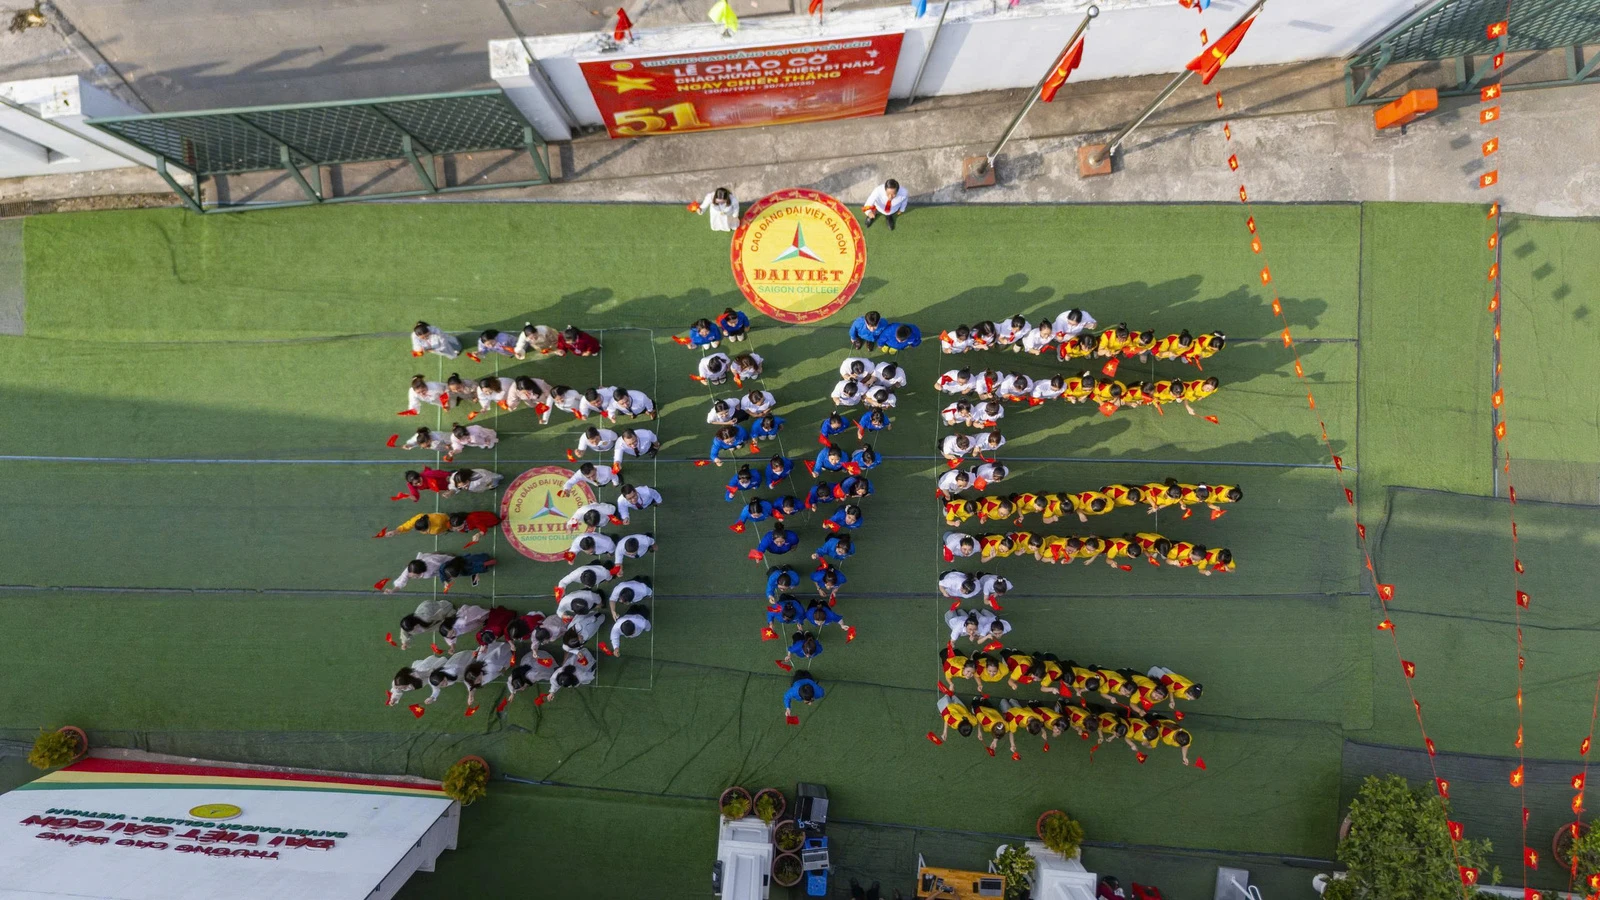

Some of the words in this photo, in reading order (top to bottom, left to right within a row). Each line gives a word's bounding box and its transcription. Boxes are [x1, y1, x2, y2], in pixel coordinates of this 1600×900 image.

[705, 59, 781, 74] CHÀO
[788, 53, 828, 67] CỜ
[675, 74, 715, 85] CHÀO
[677, 82, 723, 92] NGÀY
[613, 102, 711, 136] 51
[751, 232, 762, 252] CAO
[805, 206, 826, 220] VIỆT
[754, 269, 789, 282] ĐẠI
[794, 268, 843, 283] VIỆT
[758, 286, 795, 294] SAIGON
[796, 286, 839, 294] COLLEGE
[115, 838, 169, 850] CAO
